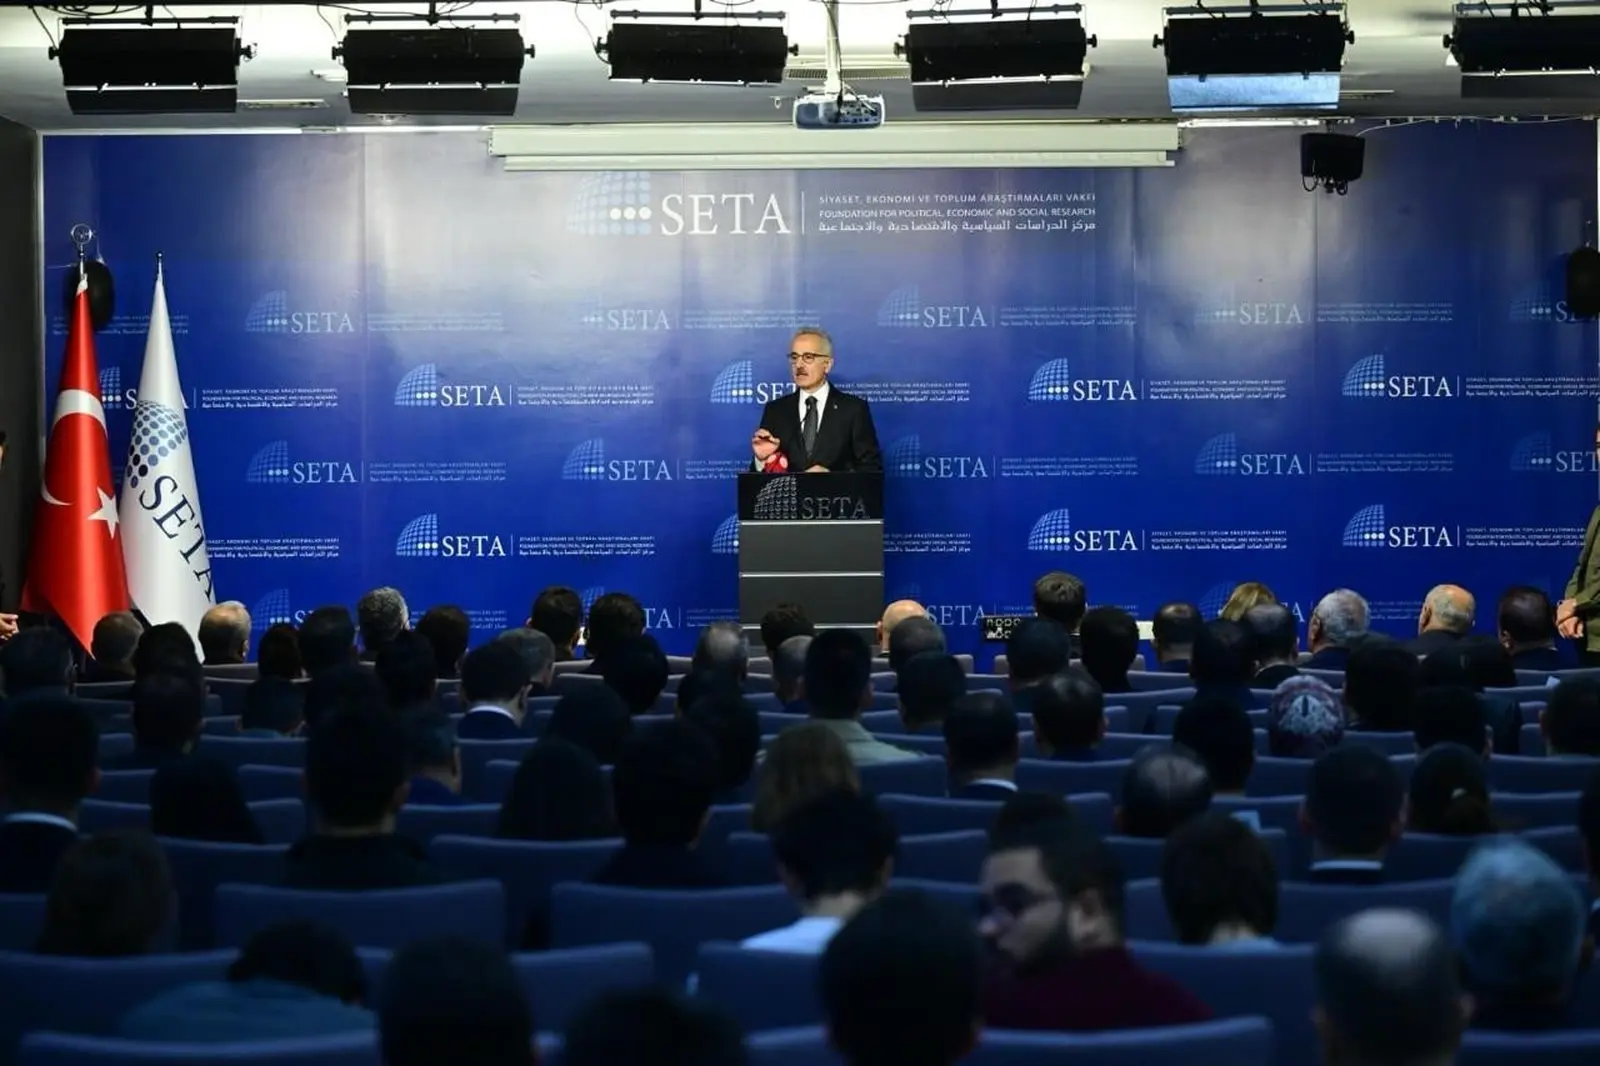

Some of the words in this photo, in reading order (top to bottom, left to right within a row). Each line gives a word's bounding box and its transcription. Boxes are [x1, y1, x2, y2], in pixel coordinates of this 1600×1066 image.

[935, 193, 976, 203] TOPLUM
[1066, 192, 1096, 202] VAKFI
[660, 193, 792, 236] SETA
[819, 209, 878, 219] FOUNDATION
[879, 209, 897, 218] FOR
[946, 208, 995, 217] ECONOMIC
[995, 208, 1016, 217] AND
[1017, 208, 1048, 217] SOCIAL
[1050, 207, 1096, 217] RESEARCH
[291, 311, 355, 334] SETA
[607, 309, 670, 331] SETA
[923, 305, 987, 328] SETA
[1240, 303, 1304, 325] SETA
[440, 385, 505, 407] SETA
[756, 382, 797, 404] SE
[1073, 379, 1137, 401] SETA
[1388, 376, 1453, 397] SETA
[608, 459, 672, 481] SETA
[924, 456, 988, 478] SETA
[1240, 454, 1304, 475] SETA
[1556, 451, 1598, 472] SET
[293, 462, 356, 484] SETA
[802, 496, 870, 519] SETA
[441, 535, 506, 557] SETA
[1074, 530, 1138, 552] SETA
[1389, 526, 1453, 548] SETA
[643, 607, 674, 628] TA
[926, 604, 985, 626] SETA
